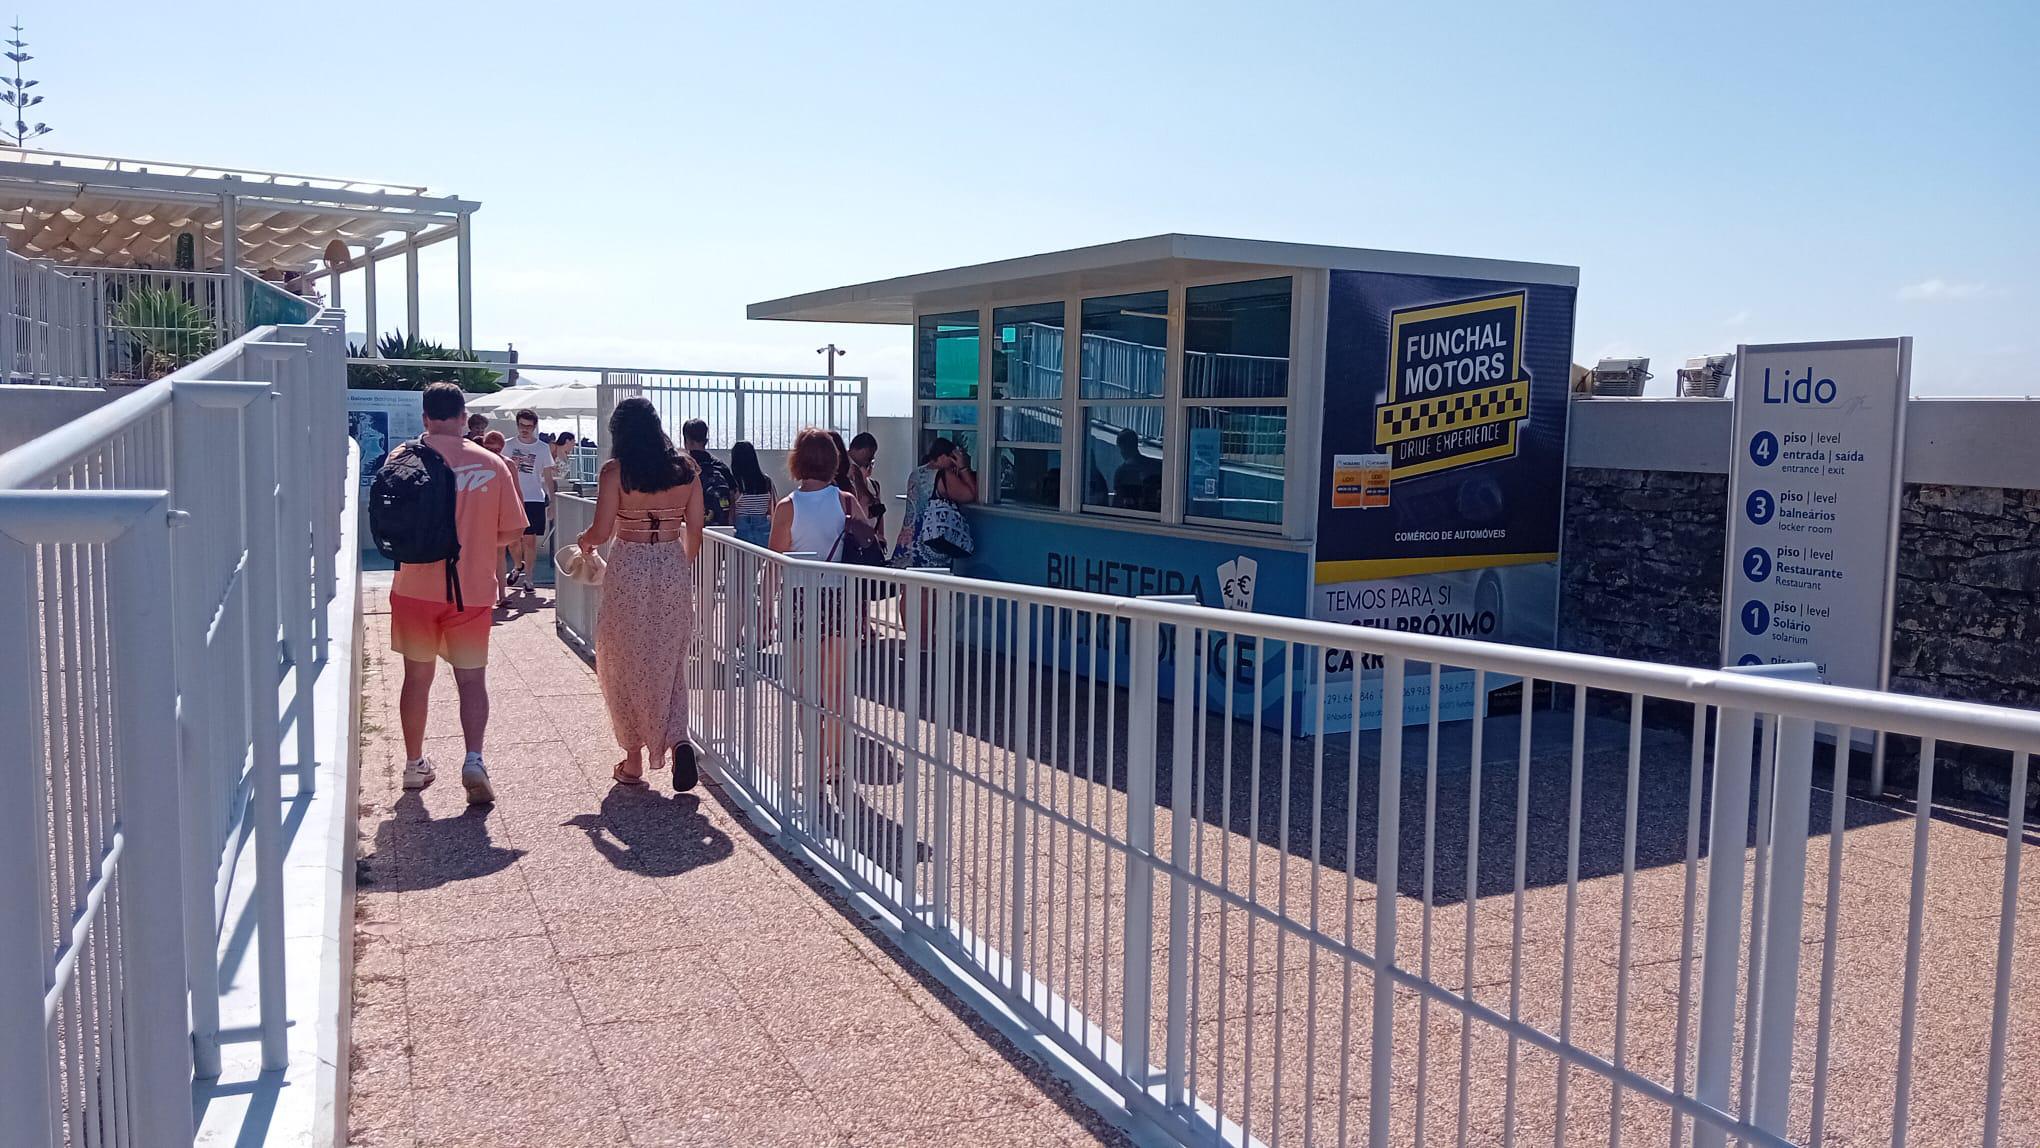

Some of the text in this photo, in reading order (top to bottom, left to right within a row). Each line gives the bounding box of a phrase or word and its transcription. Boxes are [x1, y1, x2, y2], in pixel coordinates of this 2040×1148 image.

[1406, 322, 1507, 362] FUNCHAL
[1405, 352, 1505, 395] MOTORS
[1763, 367, 1837, 404] Lido
[1400, 423, 1500, 460] DRIVE EXPERIENCE
[1783, 432, 1807, 445] piso
[1817, 432, 1841, 444] level
[1756, 438, 1770, 459] 4
[1783, 450, 1825, 460] entrada
[1835, 450, 1864, 462] saída
[1782, 465, 1819, 474] entrance
[1828, 466, 1845, 475] exit
[1780, 490, 1803, 503] piso
[1813, 491, 1837, 503] level
[1754, 497, 1767, 518] 3
[1779, 507, 1836, 521] balneários
[1394, 528, 1506, 542] COMÉRCIO DE AUTOMÓVEIS
[1778, 521, 1833, 534] locker room
[1776, 545, 1800, 558] piso
[1810, 548, 1834, 561] level
[1751, 554, 1763, 576] 2
[1776, 562, 1843, 579] Restaurante
[1775, 576, 1822, 590] Restaurant
[1326, 585, 1451, 612] TEMOS PARA SI
[1773, 601, 1797, 614] piso
[1807, 604, 1830, 618] level
[1773, 617, 1811, 632] Solário
[1772, 632, 1808, 645] solarium
